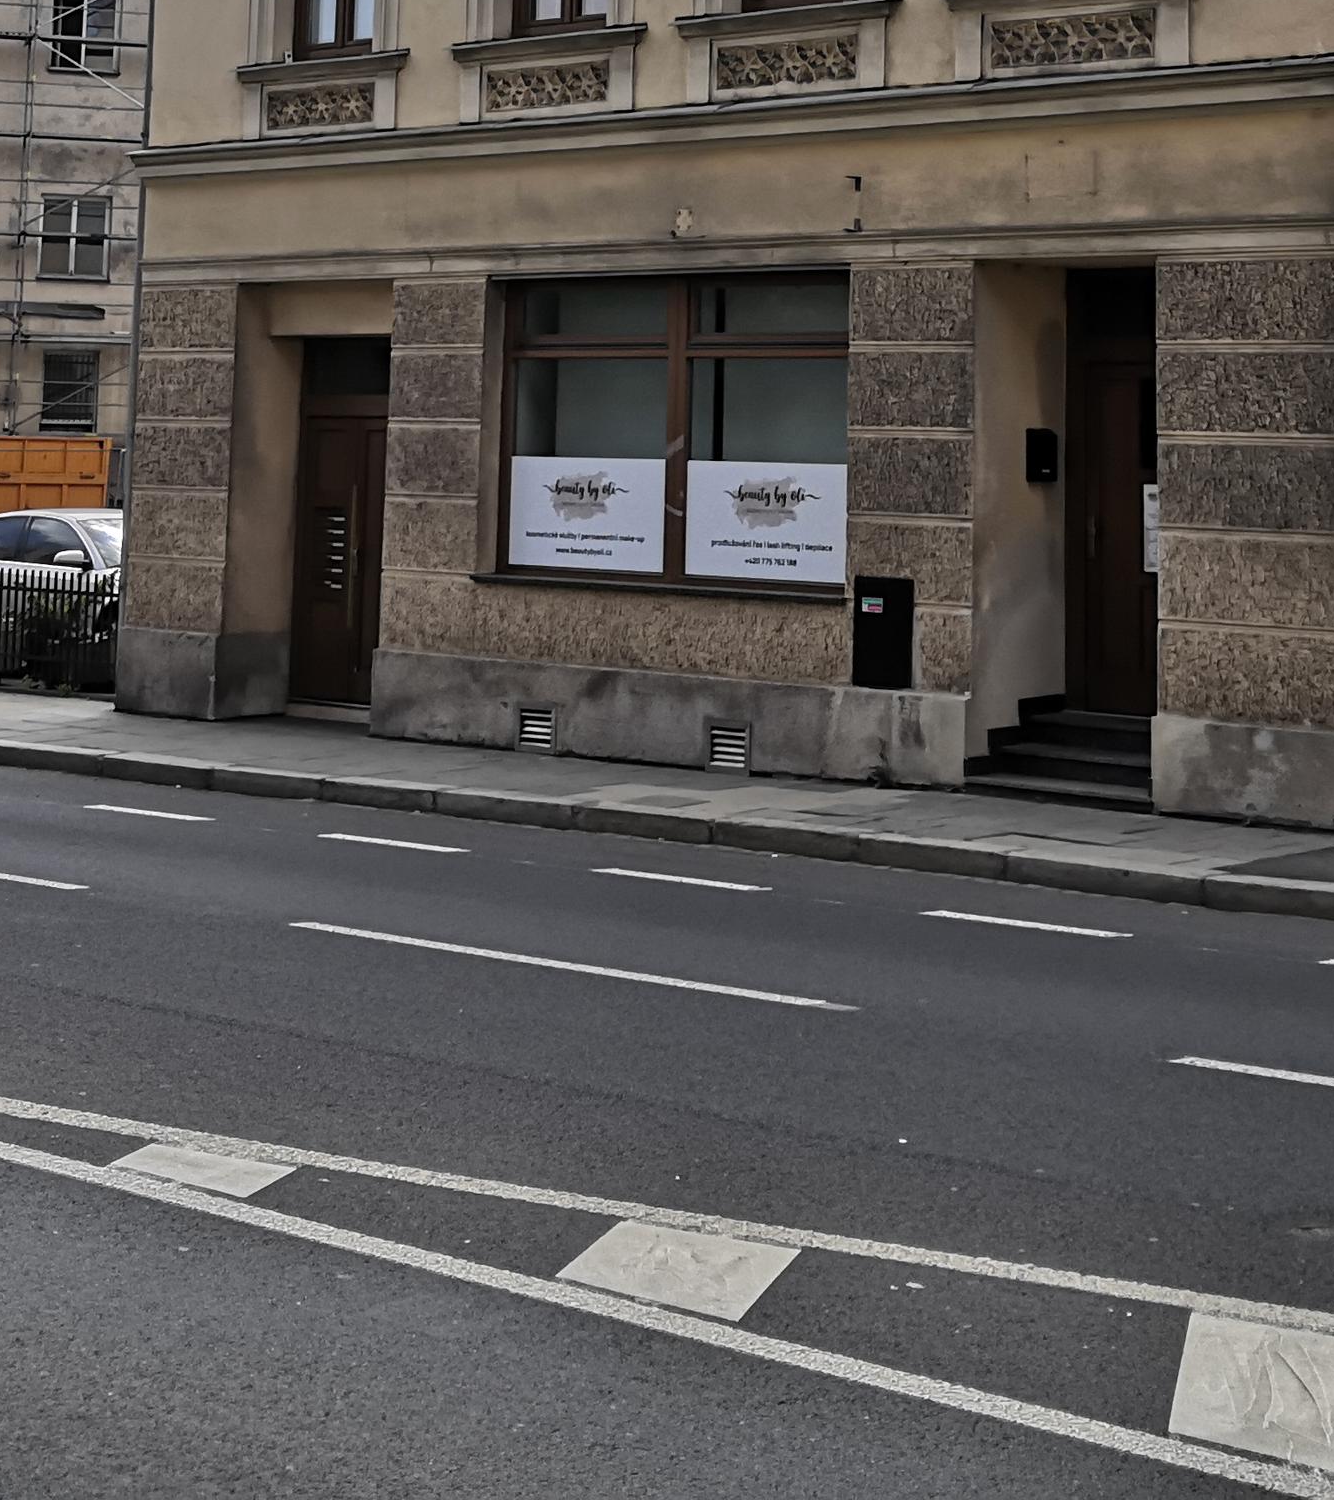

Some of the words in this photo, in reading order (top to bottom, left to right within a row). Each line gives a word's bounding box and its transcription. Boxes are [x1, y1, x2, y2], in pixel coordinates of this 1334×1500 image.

[551, 478, 585, 501] beauty
[587, 479, 599, 502] by
[734, 484, 771, 507] beauty
[774, 485, 787, 508] by
